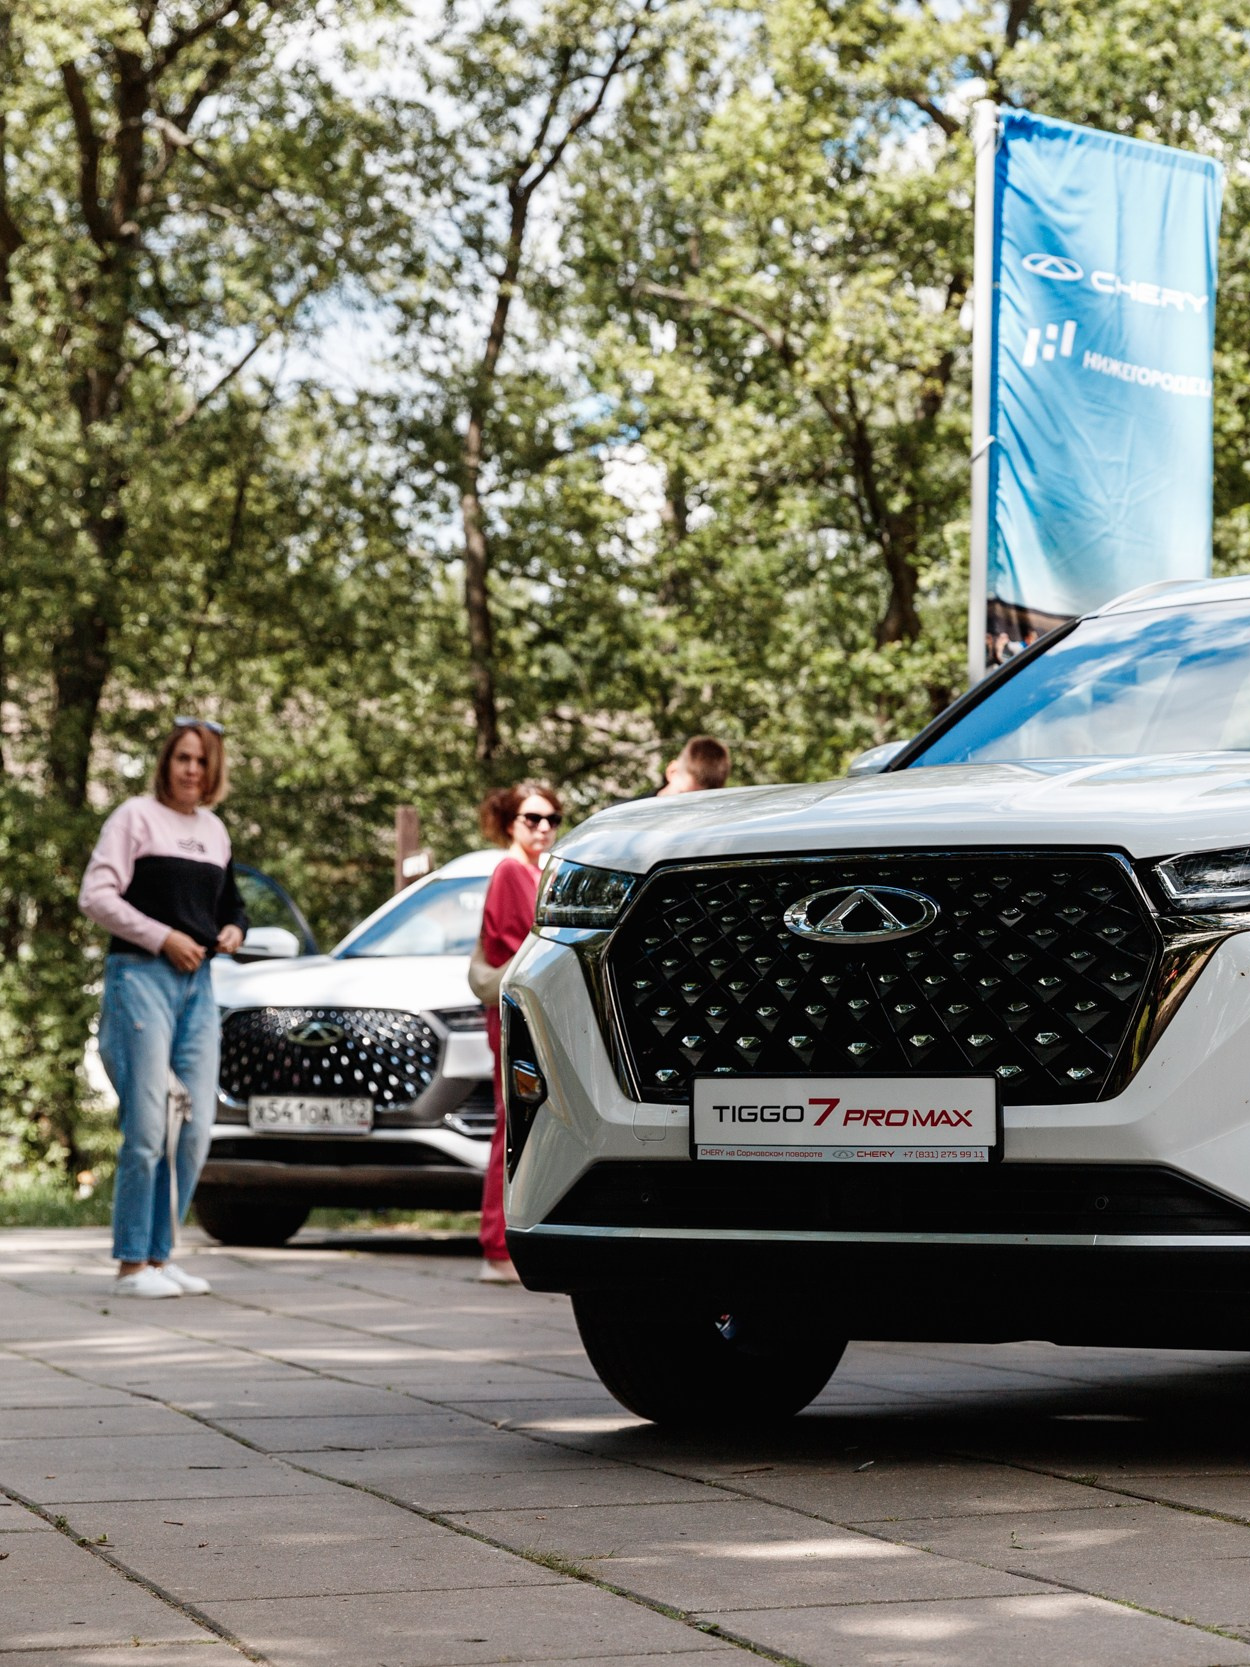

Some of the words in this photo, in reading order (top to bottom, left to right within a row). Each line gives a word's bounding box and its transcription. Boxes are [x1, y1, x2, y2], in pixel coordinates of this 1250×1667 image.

[1090, 270, 1209, 314] CHERY
[712, 1105, 805, 1123] TIGGO
[808, 1098, 841, 1126] 7
[736, 1149, 784, 1158] Сормовском
[785, 1151, 824, 1159] повороте
[856, 1150, 896, 1158] CHERY
[915, 1150, 939, 1159] (831)
